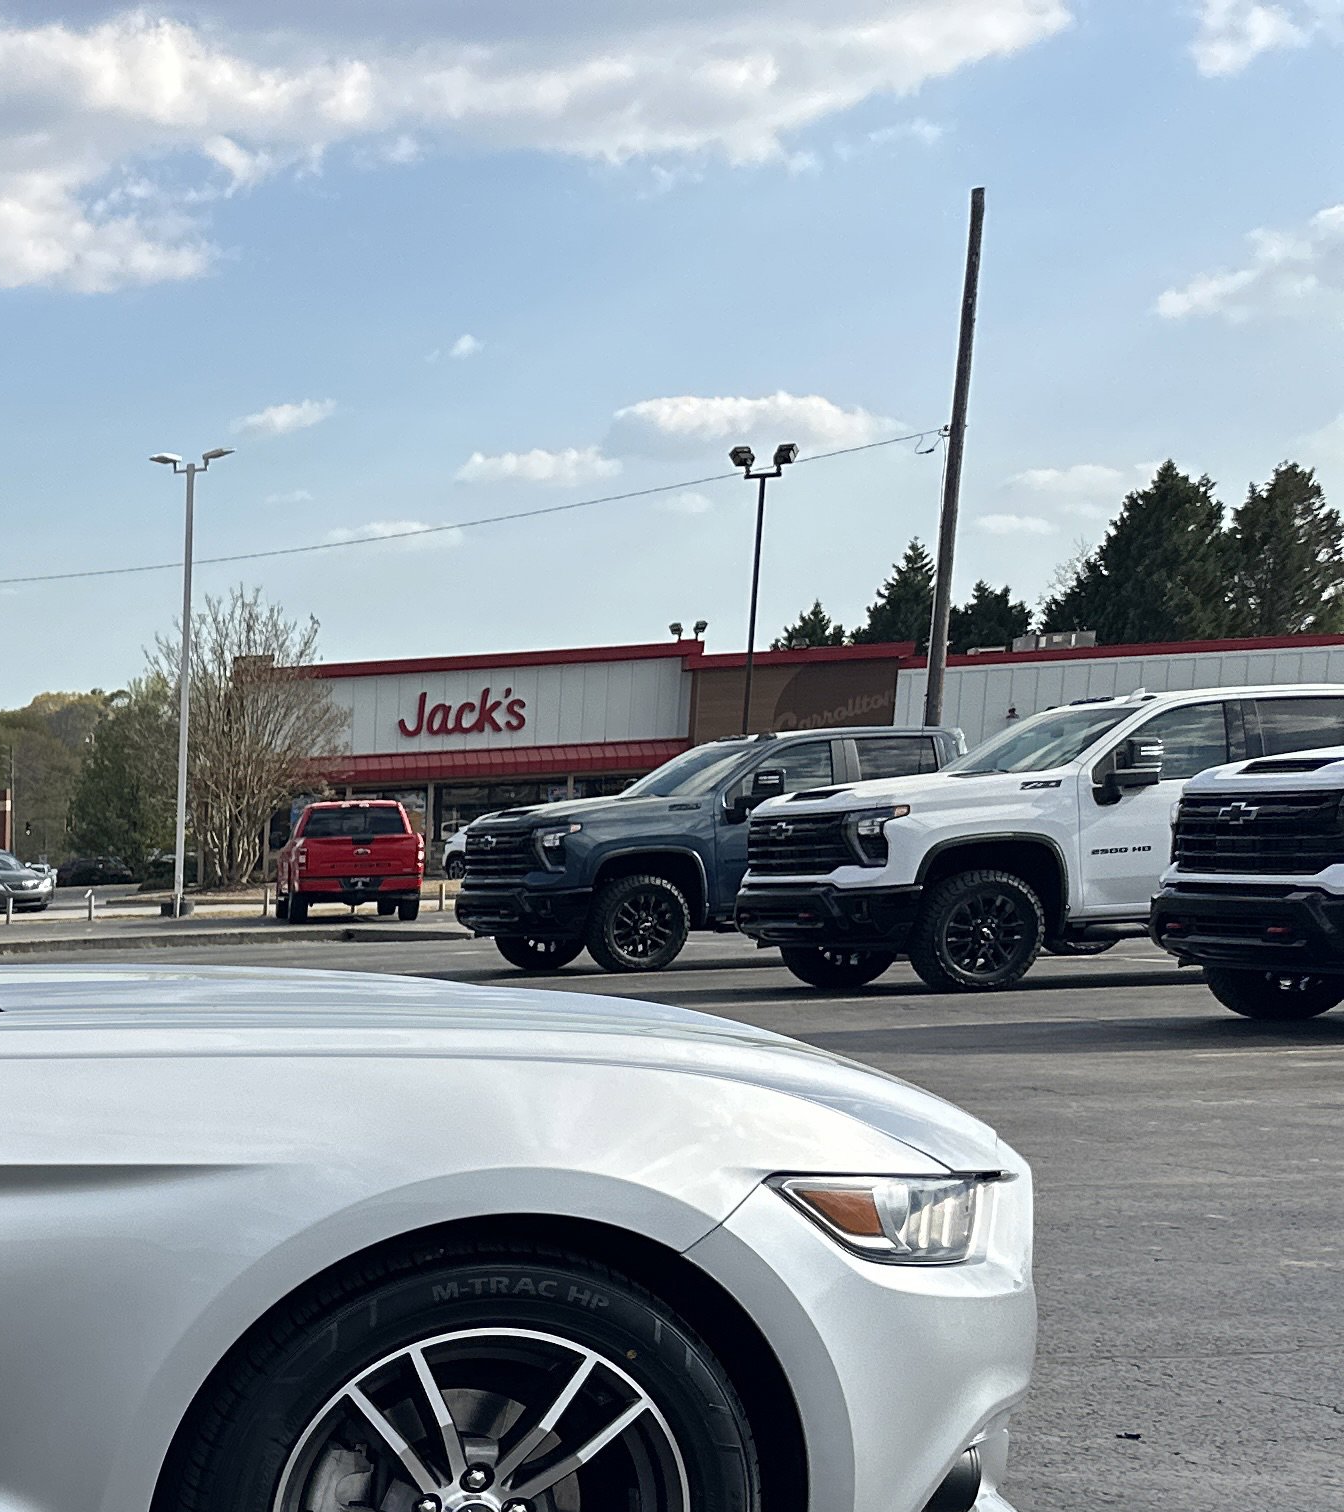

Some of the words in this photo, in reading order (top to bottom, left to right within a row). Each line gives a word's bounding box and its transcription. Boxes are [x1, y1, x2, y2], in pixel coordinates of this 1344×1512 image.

[398, 687, 526, 737] Jack's
[432, 1277, 558, 1301] M-TRAC
[567, 1286, 610, 1309] HP
